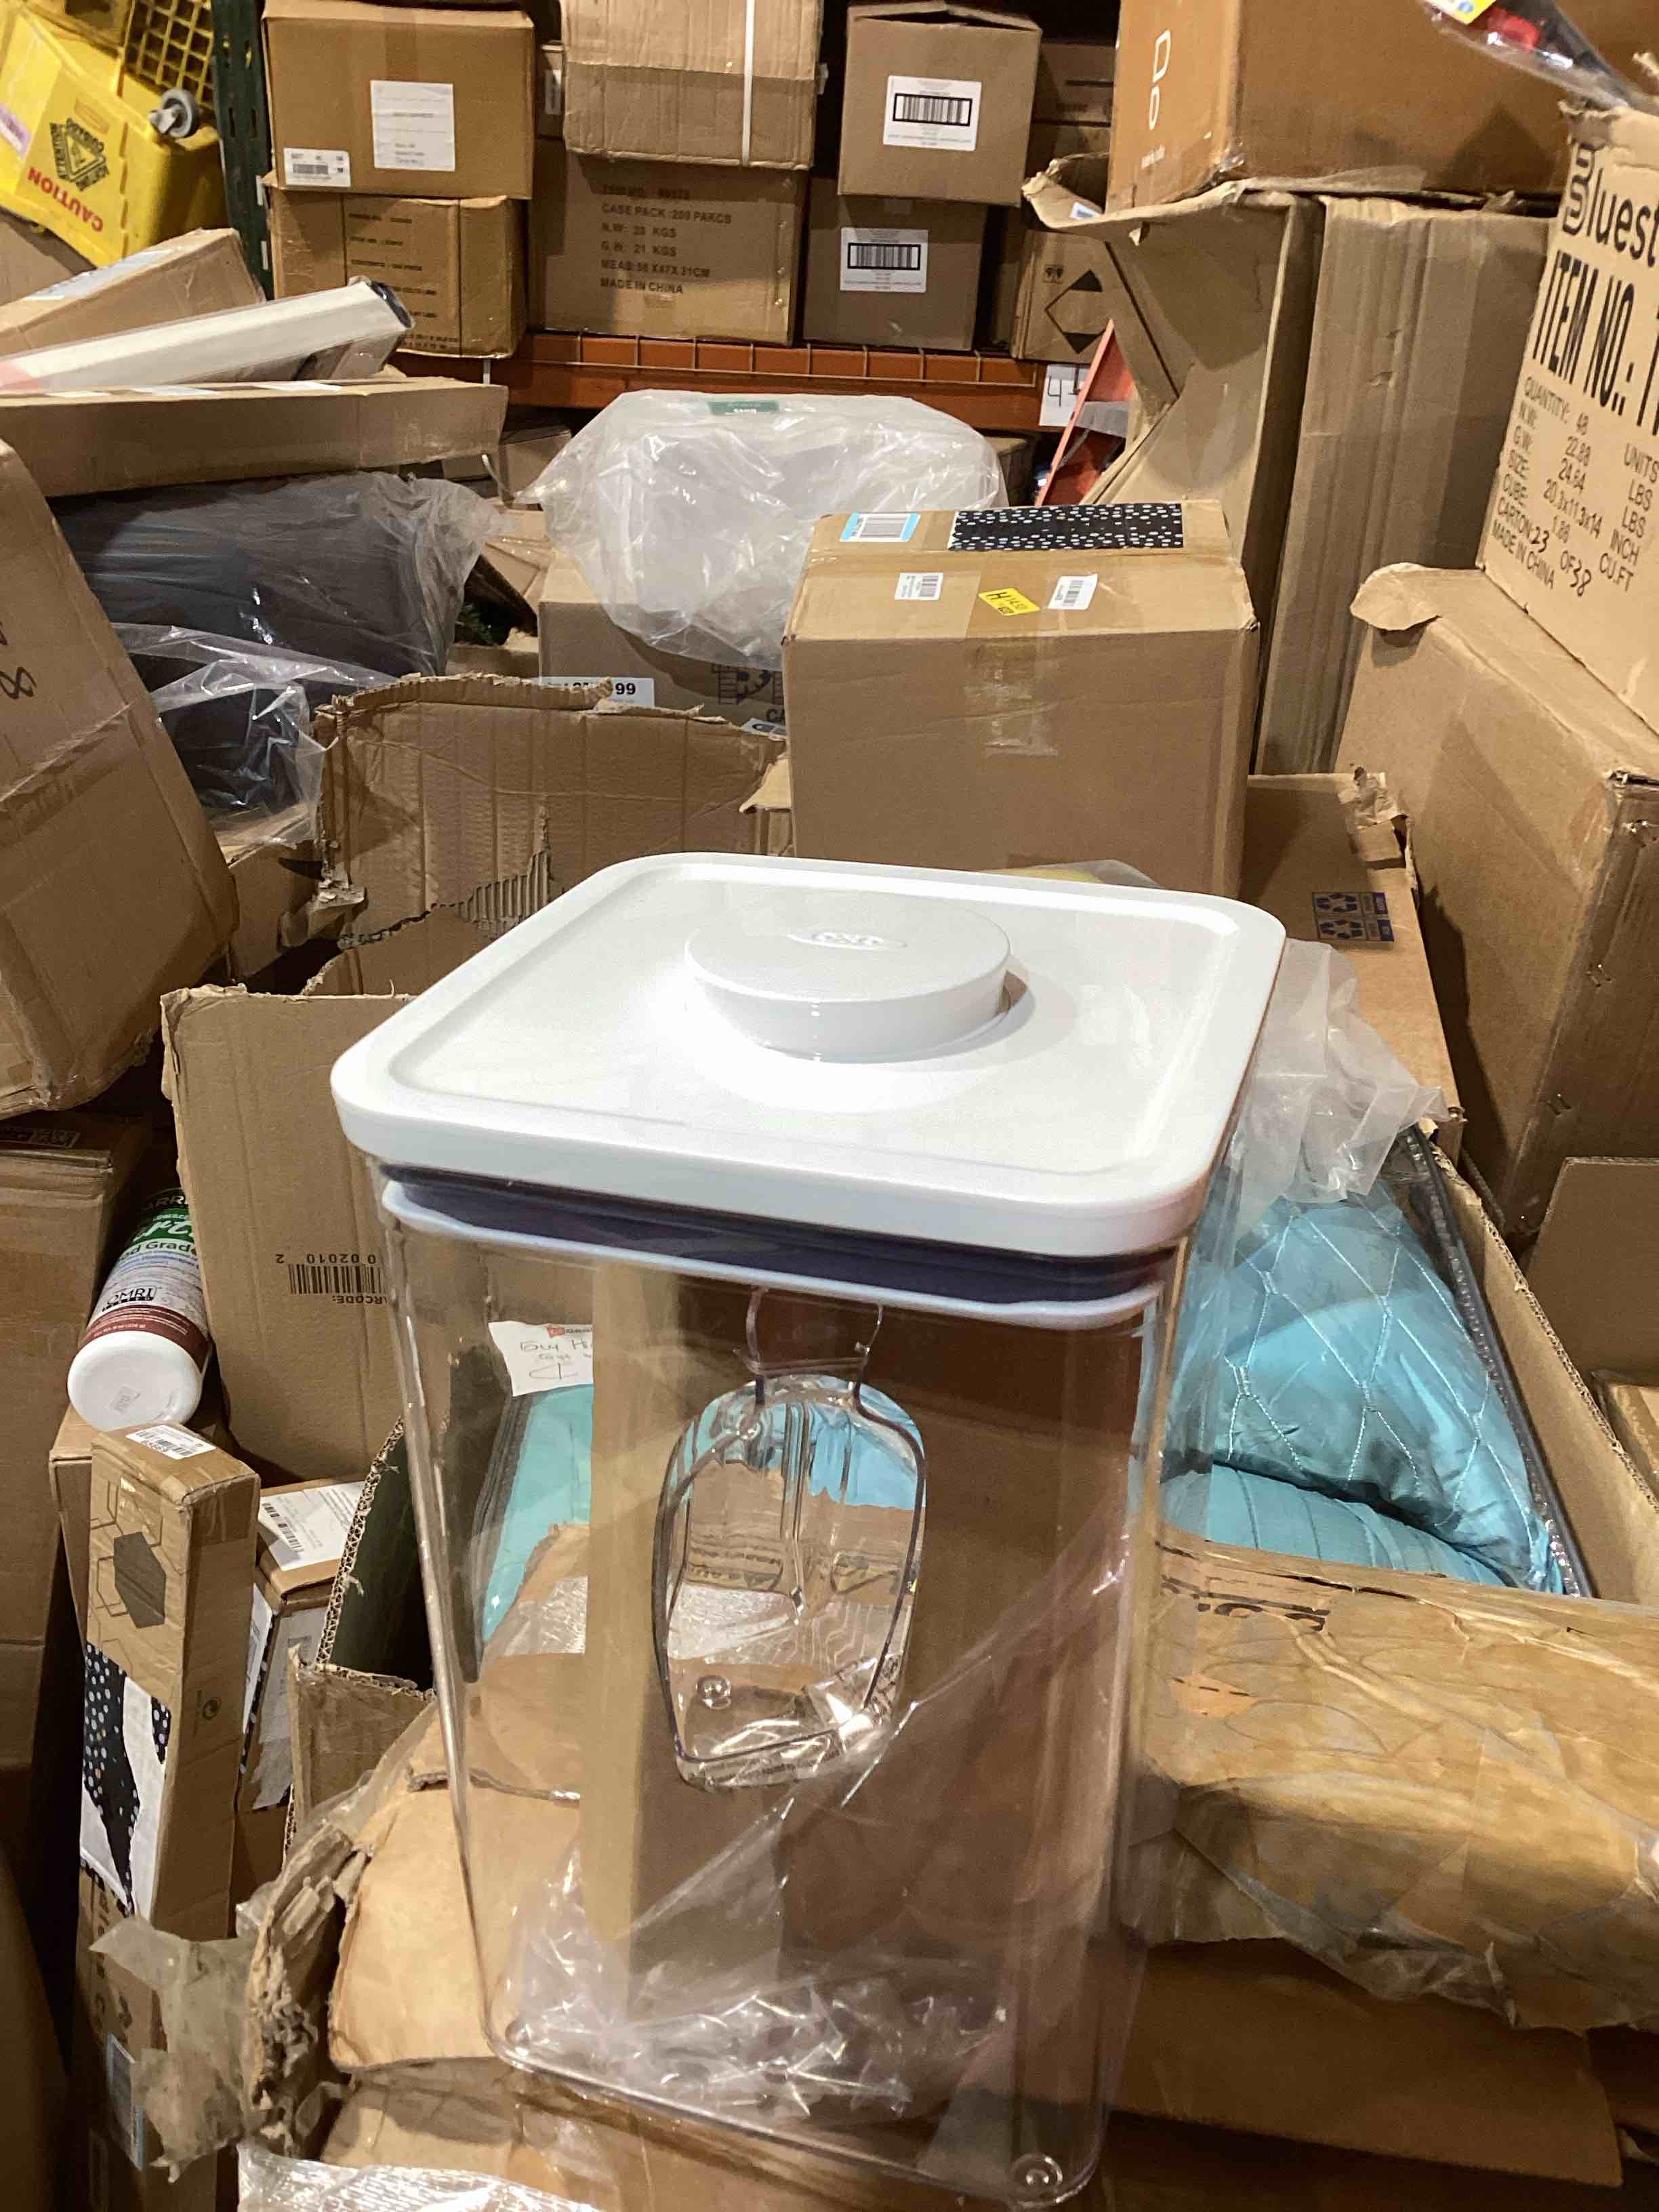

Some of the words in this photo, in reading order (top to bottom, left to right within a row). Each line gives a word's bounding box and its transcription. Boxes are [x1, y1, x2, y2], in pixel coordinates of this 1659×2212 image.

[27, 166, 104, 232] CAUTION
[648, 282, 684, 294] CHINA
[1532, 249, 1599, 384] ITEM
[1624, 443, 1659, 483] UNITS
[1628, 478, 1653, 512] LBS
[1622, 506, 1647, 538] LBS
[1492, 518, 1517, 554] MADE
[1526, 550, 1555, 590] CHINA
[1530, 526, 1550, 554] 23
[1610, 529, 1641, 566] INCH
[1560, 550, 1576, 573] OF
[276, 1254, 285, 1264] 2
